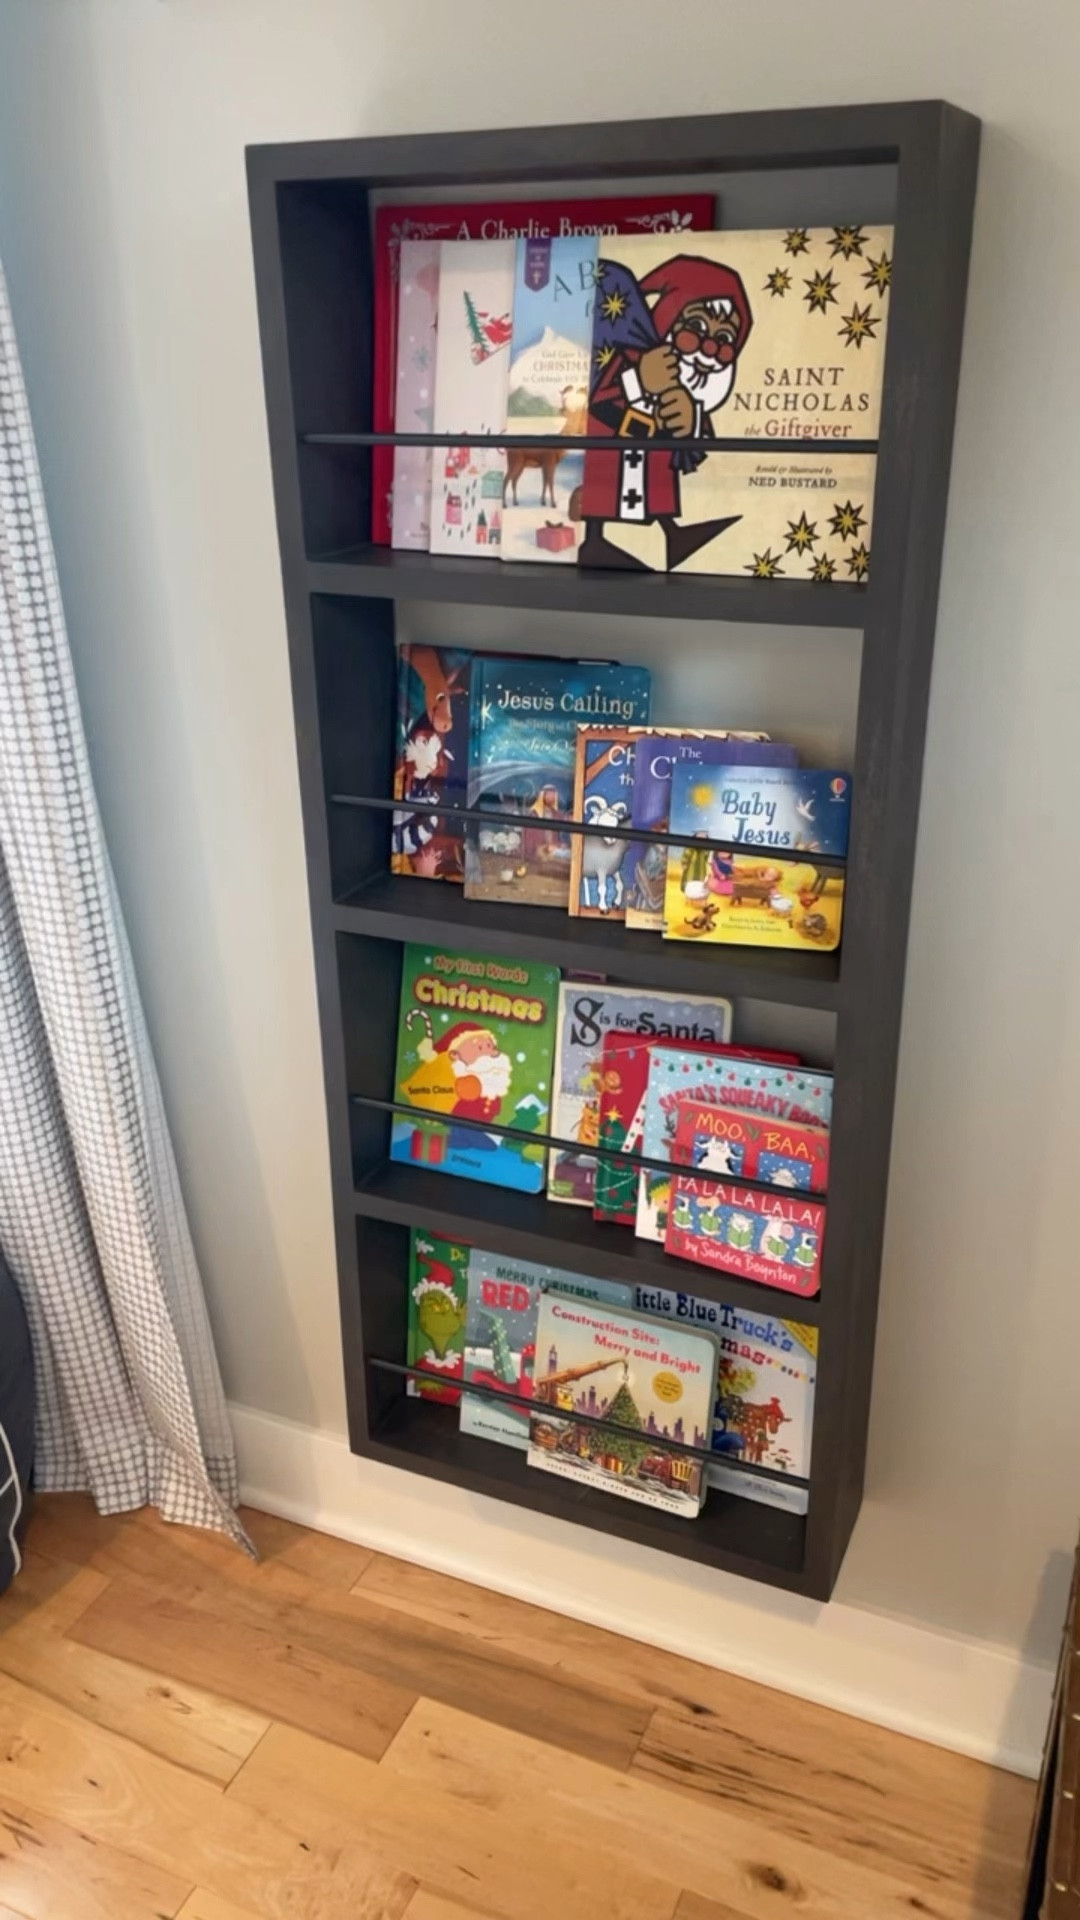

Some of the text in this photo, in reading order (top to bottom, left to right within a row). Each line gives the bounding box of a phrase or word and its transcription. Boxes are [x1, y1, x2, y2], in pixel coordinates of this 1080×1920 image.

[456, 217, 618, 240] A Charlie Brown
[763, 367, 845, 387] SAINT
[733, 392, 870, 412] NICHOLAS
[744, 417, 852, 440] the Giftgiver
[748, 477, 838, 489] NED BUSTARD
[498, 690, 635, 720] Jesus Calling
[680, 747, 702, 759] The
[619, 774, 635, 787] th
[721, 789, 777, 825] Baby
[732, 817, 792, 845] Jesus
[434, 955, 529, 984] My First Words
[414, 977, 544, 1023] Christmas
[570, 997, 716, 1047] S is for Santa
[408, 1085, 454, 1096] Santa Claus
[658, 1084, 717, 1115] SANTA'S
[720, 1085, 790, 1120] SQUEAKY
[695, 1111, 816, 1162] MOO, BAA,
[677, 1175, 821, 1228] FA LA LA LA LA!
[451, 1248, 466, 1262] Dr.
[684, 1240, 797, 1284] by Sandra Boynton
[482, 1278, 531, 1313] RED
[552, 1305, 660, 1346] Construction Site:
[636, 1287, 671, 1312] ittle
[677, 1292, 717, 1322] Blue
[721, 1303, 794, 1352] Truck's
[594, 1334, 701, 1374] Merry and Bright
[721, 1336, 766, 1366] mas
